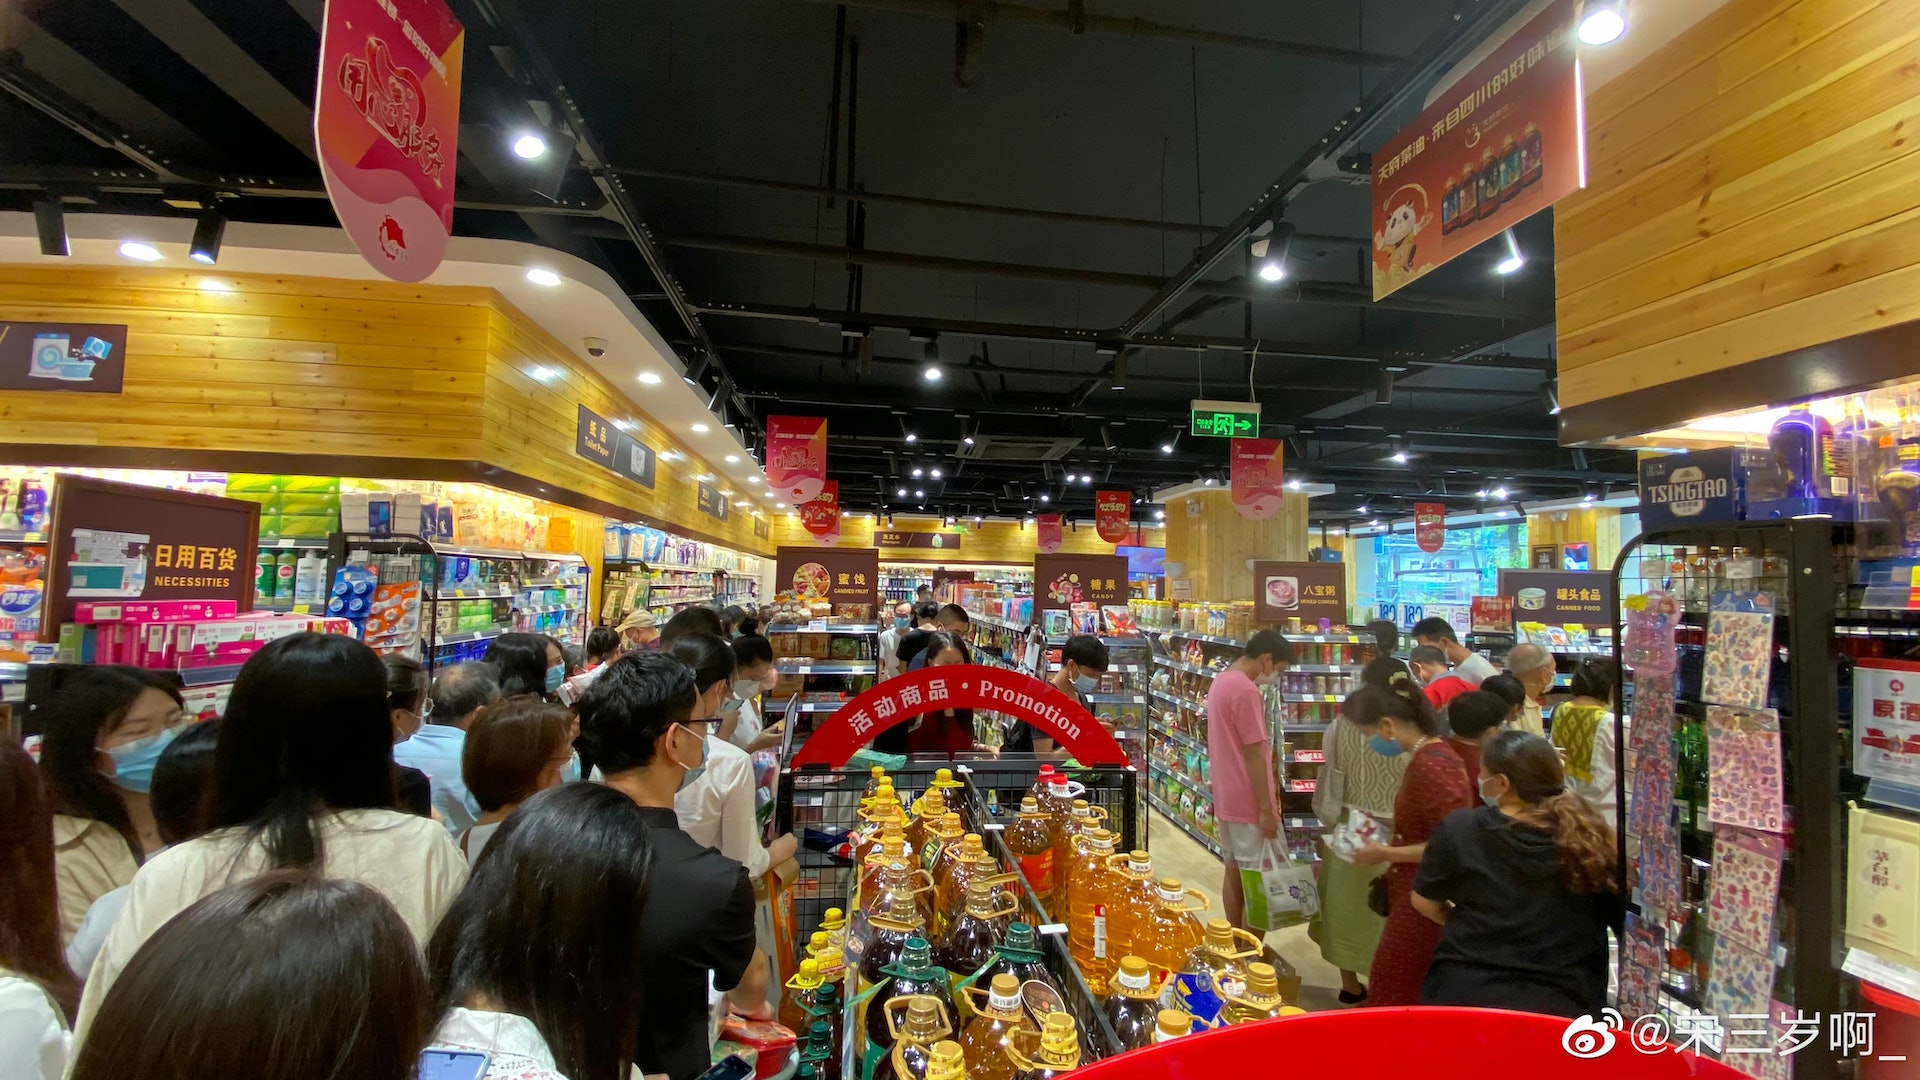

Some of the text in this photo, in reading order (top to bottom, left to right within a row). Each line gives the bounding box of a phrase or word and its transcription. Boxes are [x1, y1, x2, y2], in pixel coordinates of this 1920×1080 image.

[589, 419, 607, 444] 纸品
[597, 443, 609, 457] Paper
[1648, 478, 1727, 504] TSINGTAO
[155, 544, 237, 571] 日用百货
[154, 576, 230, 588] NECESSITIES
[838, 573, 866, 585] 蜜饯
[1090, 578, 1116, 590] 糖果
[1303, 584, 1336, 597] 八宝粥
[1556, 588, 1601, 601] 罐头食品
[847, 678, 949, 737] 活动商品
[979, 679, 1082, 741] Promotion
